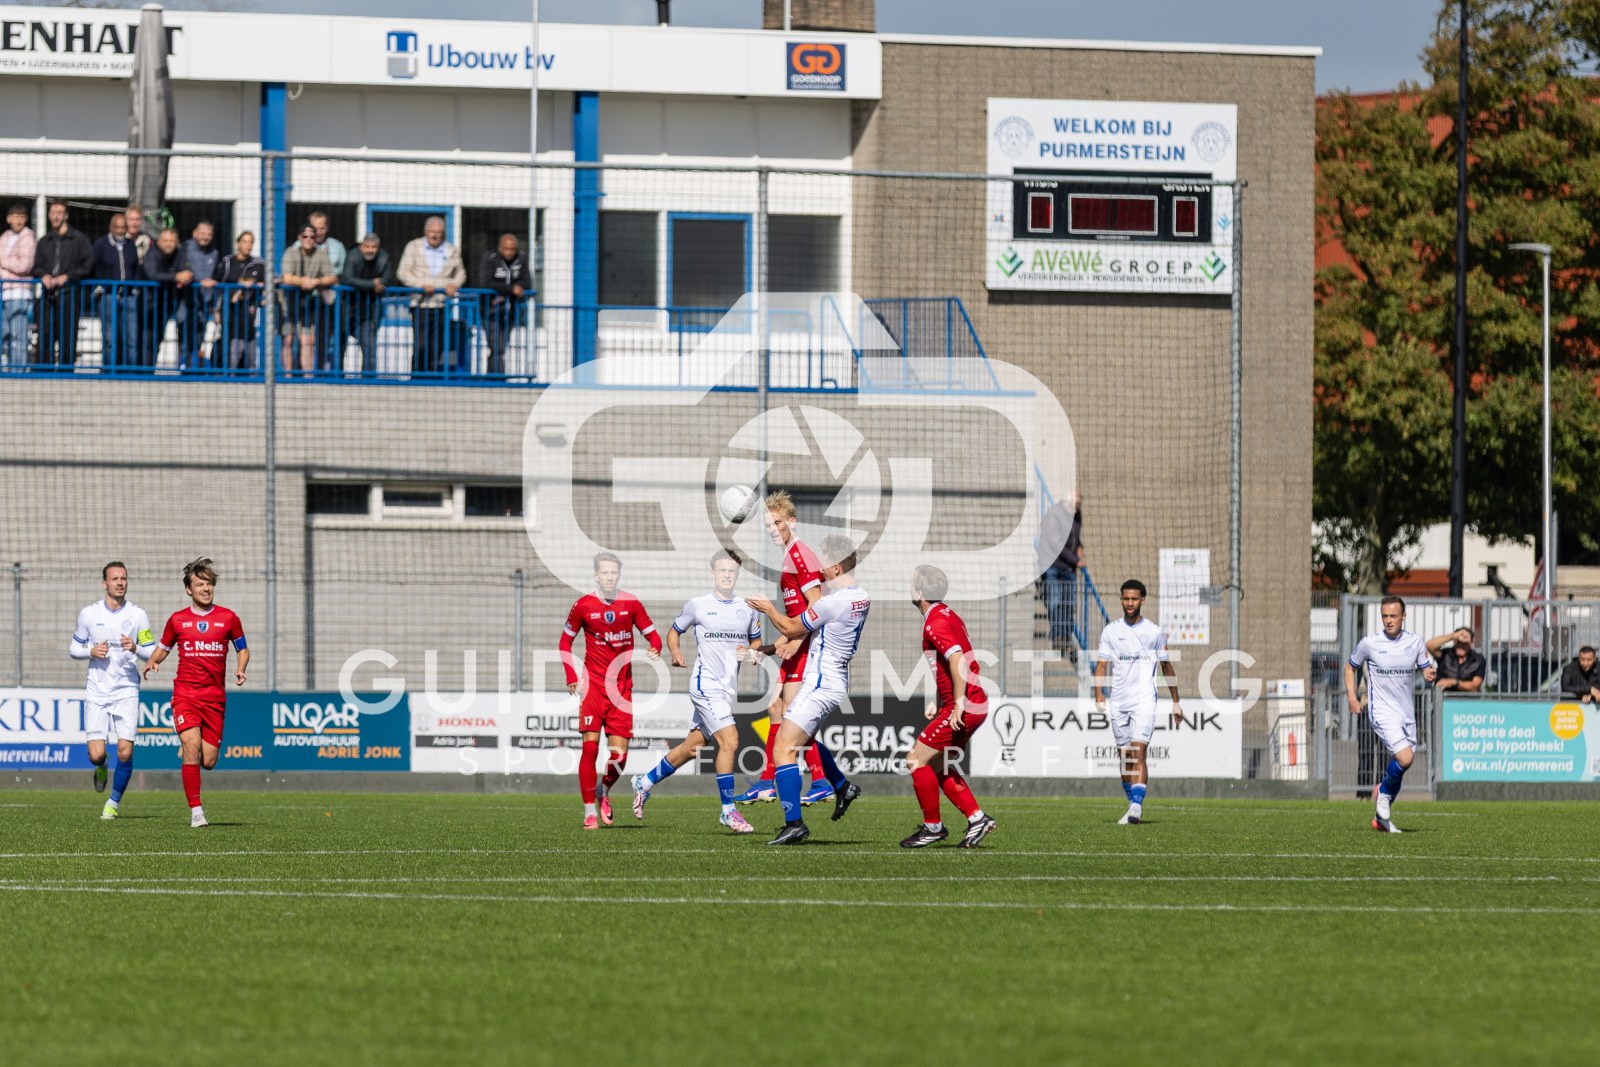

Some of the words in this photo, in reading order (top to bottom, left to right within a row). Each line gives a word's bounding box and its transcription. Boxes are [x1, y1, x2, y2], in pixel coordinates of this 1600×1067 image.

[525, 46, 555, 70] bv
[1053, 117, 1136, 136] WELKOM
[1143, 121, 1173, 136] BIJ
[1040, 142, 1186, 161] PURMERSTEIJN
[1109, 259, 1193, 275] GROEP
[604, 629, 631, 641] Nelis
[195, 641, 223, 651] Nelis
[272, 702, 360, 733] INQAR
[438, 717, 496, 727] HONDA
[583, 716, 593, 726] 17
[1031, 711, 1223, 731] RABLINK
[1453, 714, 1487, 725] scoor
[1490, 714, 1505, 725] nu
[1453, 727, 1469, 738] de
[1471, 726, 1506, 738] beste
[1508, 726, 1535, 738] deal
[134, 735, 181, 746] AUTOVE
[273, 735, 360, 746] AUTOVERHUUR
[433, 735, 455, 746] Adrie
[1453, 741, 1480, 752] voor
[1481, 740, 1494, 753] je
[1496, 740, 1564, 753] hypotheek!
[224, 746, 263, 758] JONK
[318, 746, 360, 758] ADRIE
[364, 746, 402, 758] JONK
[853, 757, 908, 772] SERVICE
[1465, 759, 1573, 773] vixx.nl/purmerend
